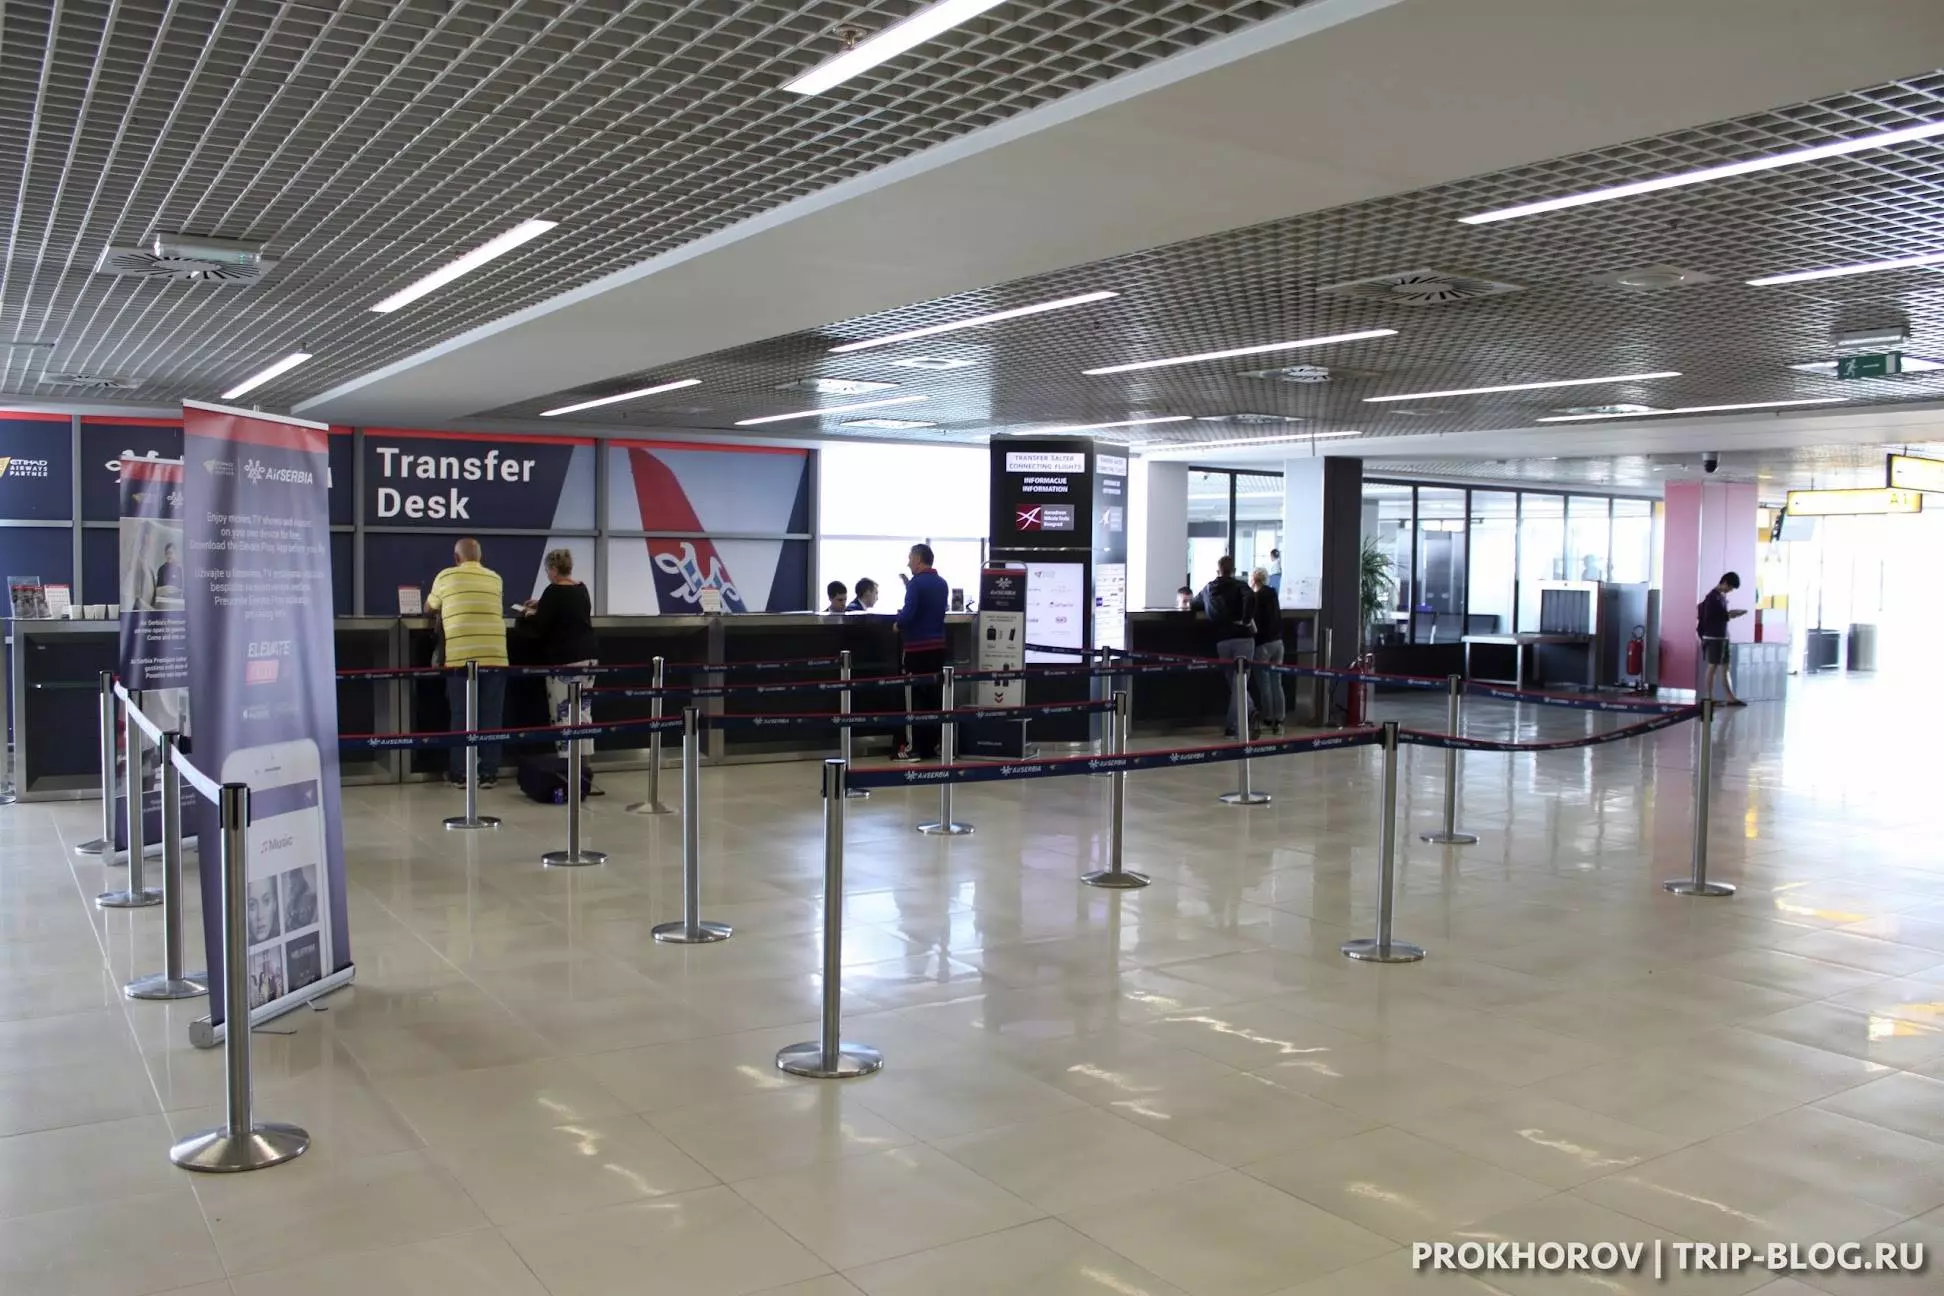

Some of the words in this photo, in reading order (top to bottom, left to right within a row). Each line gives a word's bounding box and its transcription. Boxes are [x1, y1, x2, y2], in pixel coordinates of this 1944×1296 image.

[376, 446, 535, 483] Transfer
[207, 512, 227, 525] Enjoy
[376, 487, 470, 519] Desk
